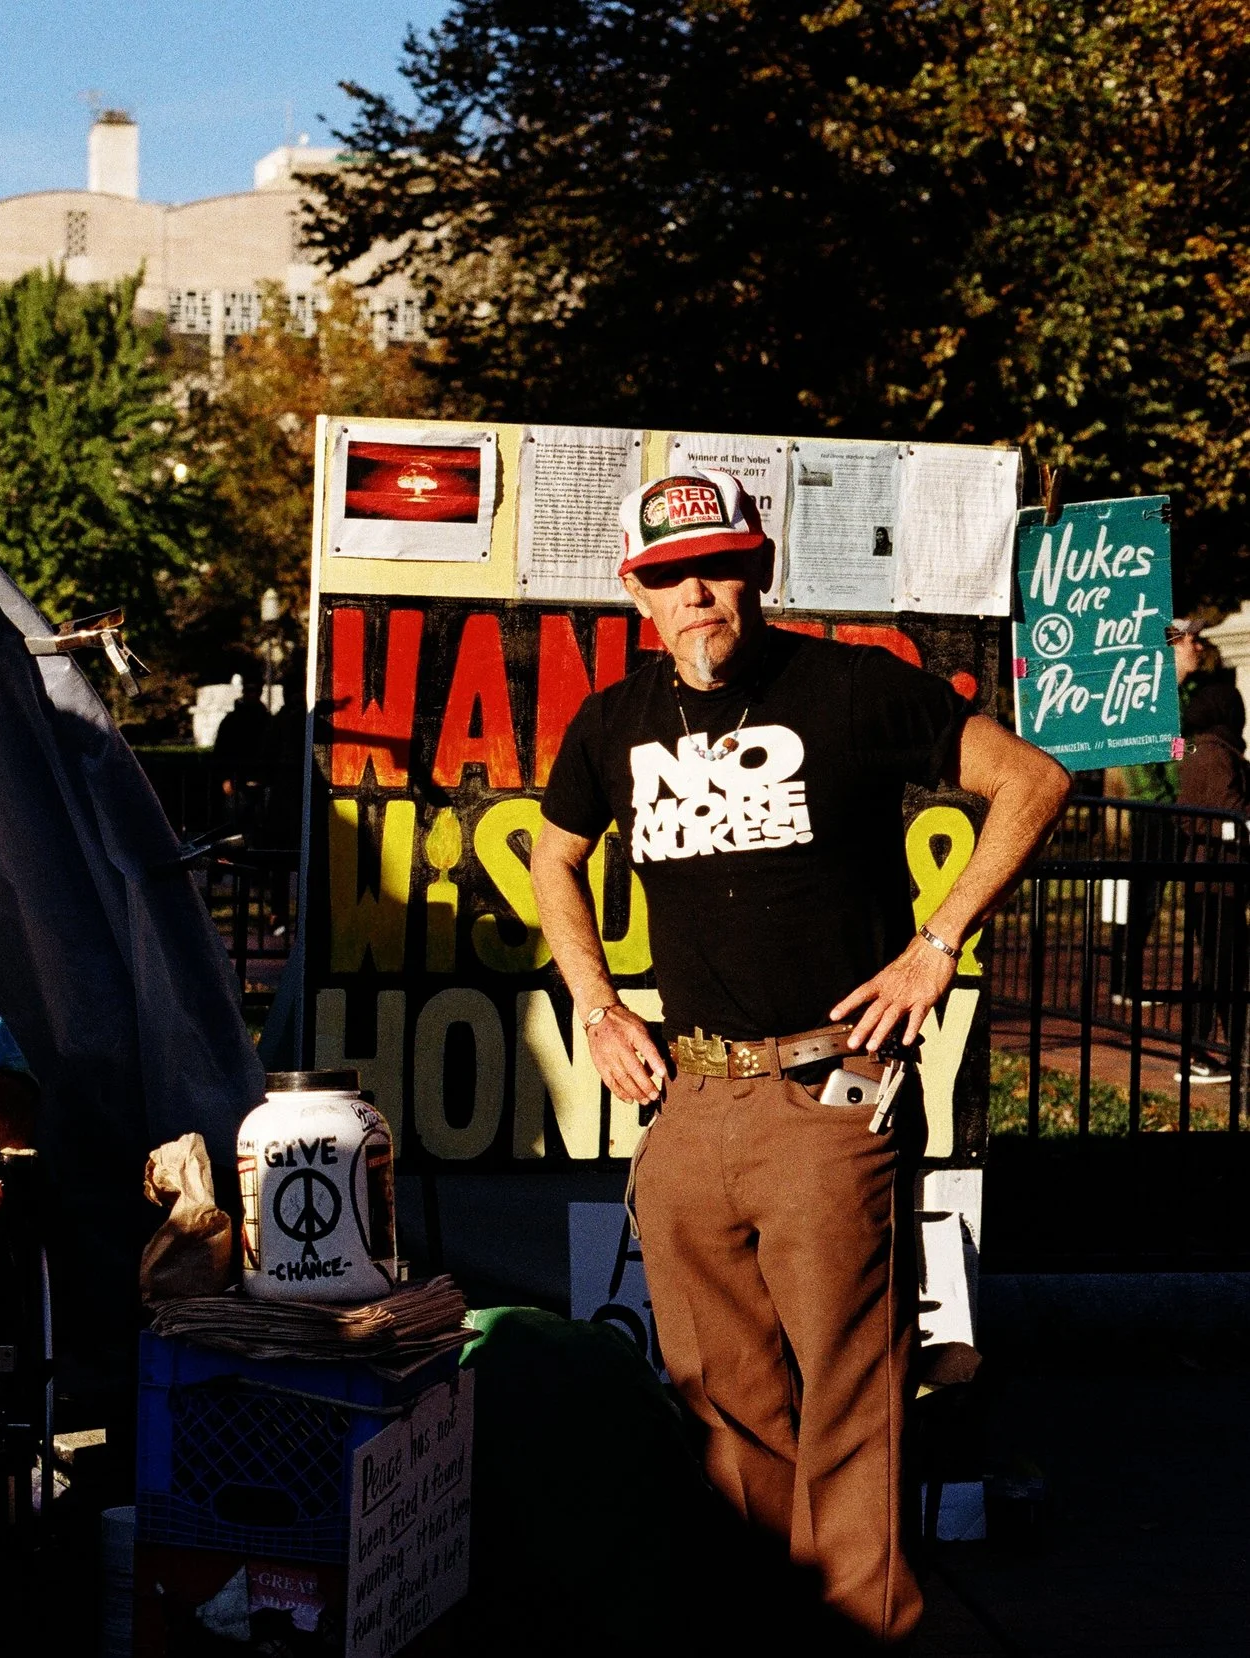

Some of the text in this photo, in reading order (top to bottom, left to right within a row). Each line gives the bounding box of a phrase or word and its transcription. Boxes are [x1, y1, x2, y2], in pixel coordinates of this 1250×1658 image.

[688, 453, 771, 464] Winner of the Nobel
[743, 468, 767, 477] 2017
[667, 488, 715, 504] RED
[669, 501, 719, 520] MAN
[1030, 522, 1155, 607] Nukes
[1066, 585, 1111, 618] are
[1094, 592, 1159, 647] not
[630, 724, 804, 808] NO
[634, 781, 806, 832] MORE
[631, 805, 814, 864] NUKES!
[264, 1136, 338, 1168] GIVE
[301, 1240, 319, 1262] A
[362, 1398, 457, 1511] Peace has not
[358, 1527, 386, 1563] been
[431, 1442, 465, 1496] found
